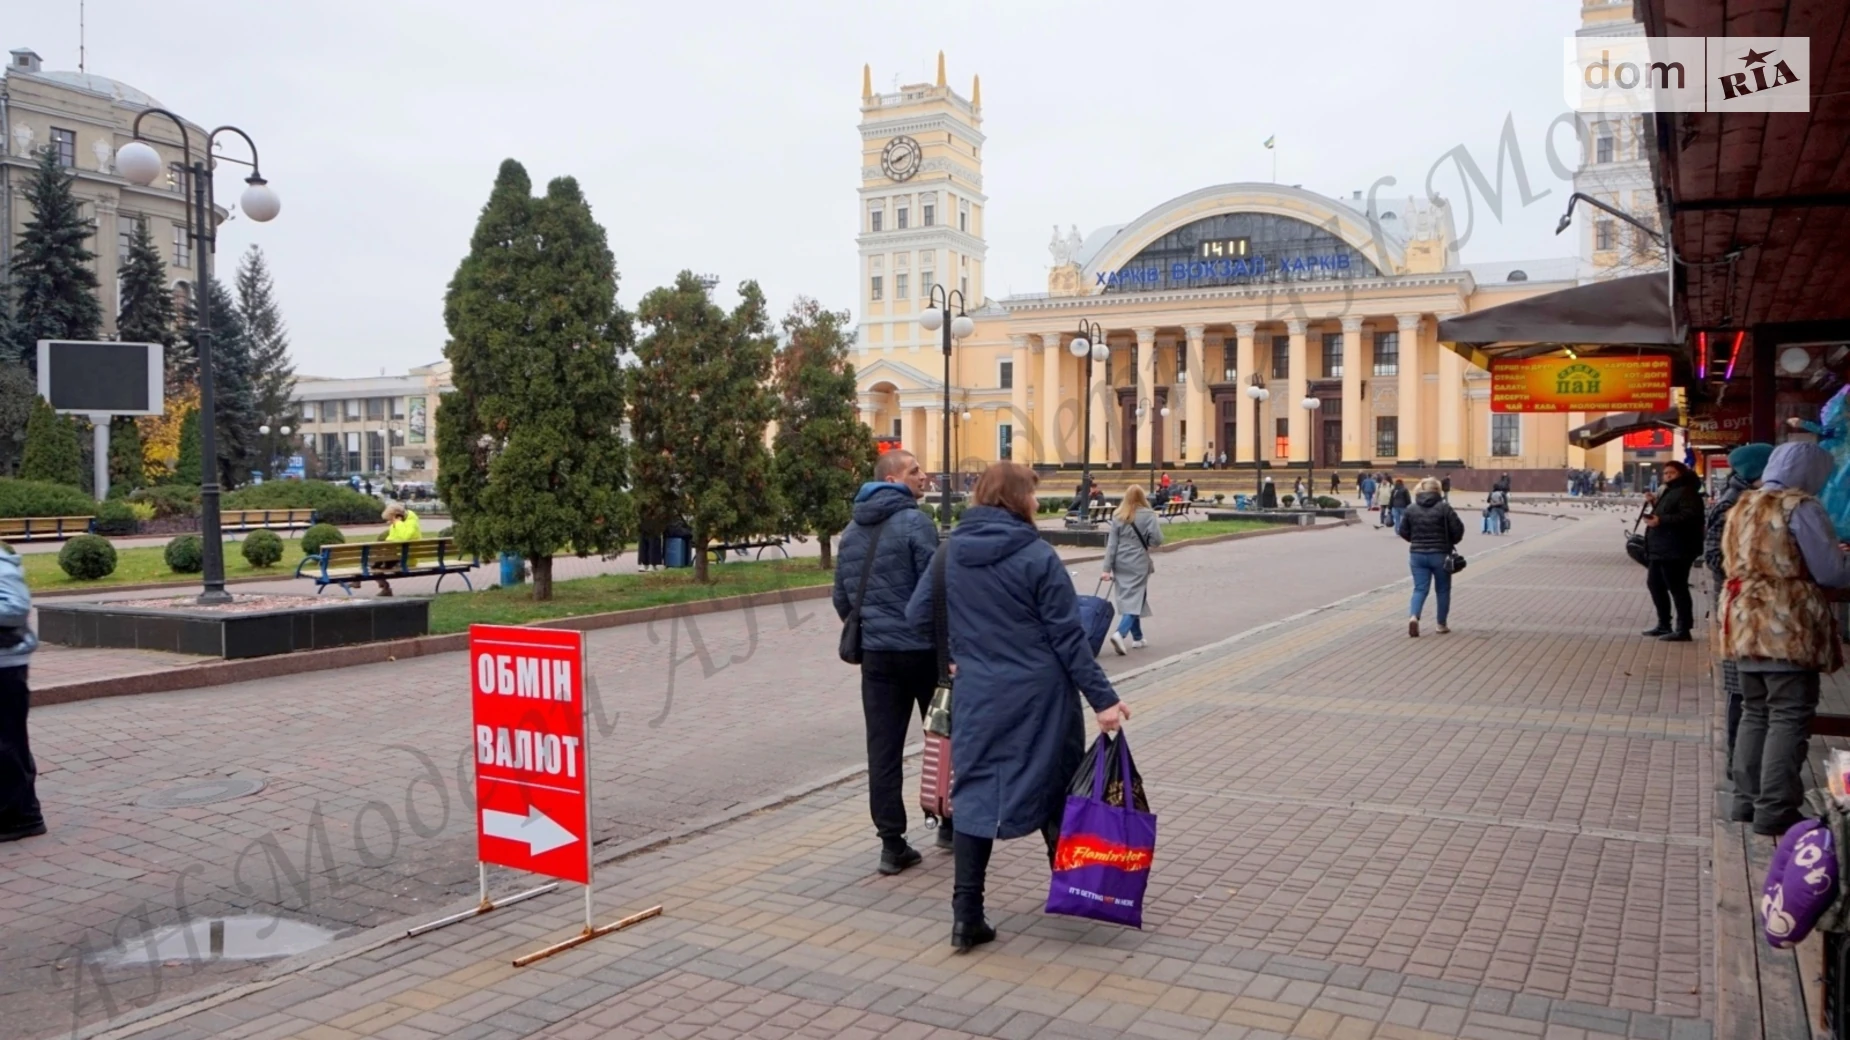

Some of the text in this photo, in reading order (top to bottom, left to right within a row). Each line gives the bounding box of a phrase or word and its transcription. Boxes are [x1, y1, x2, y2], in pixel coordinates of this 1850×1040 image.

[1095, 254, 1350, 286] ХАРКІВ ВОКЗАЛ ХАРКІВ
[477, 653, 573, 702] ОБМІН
[476, 724, 579, 778] ВАЛЮТ
